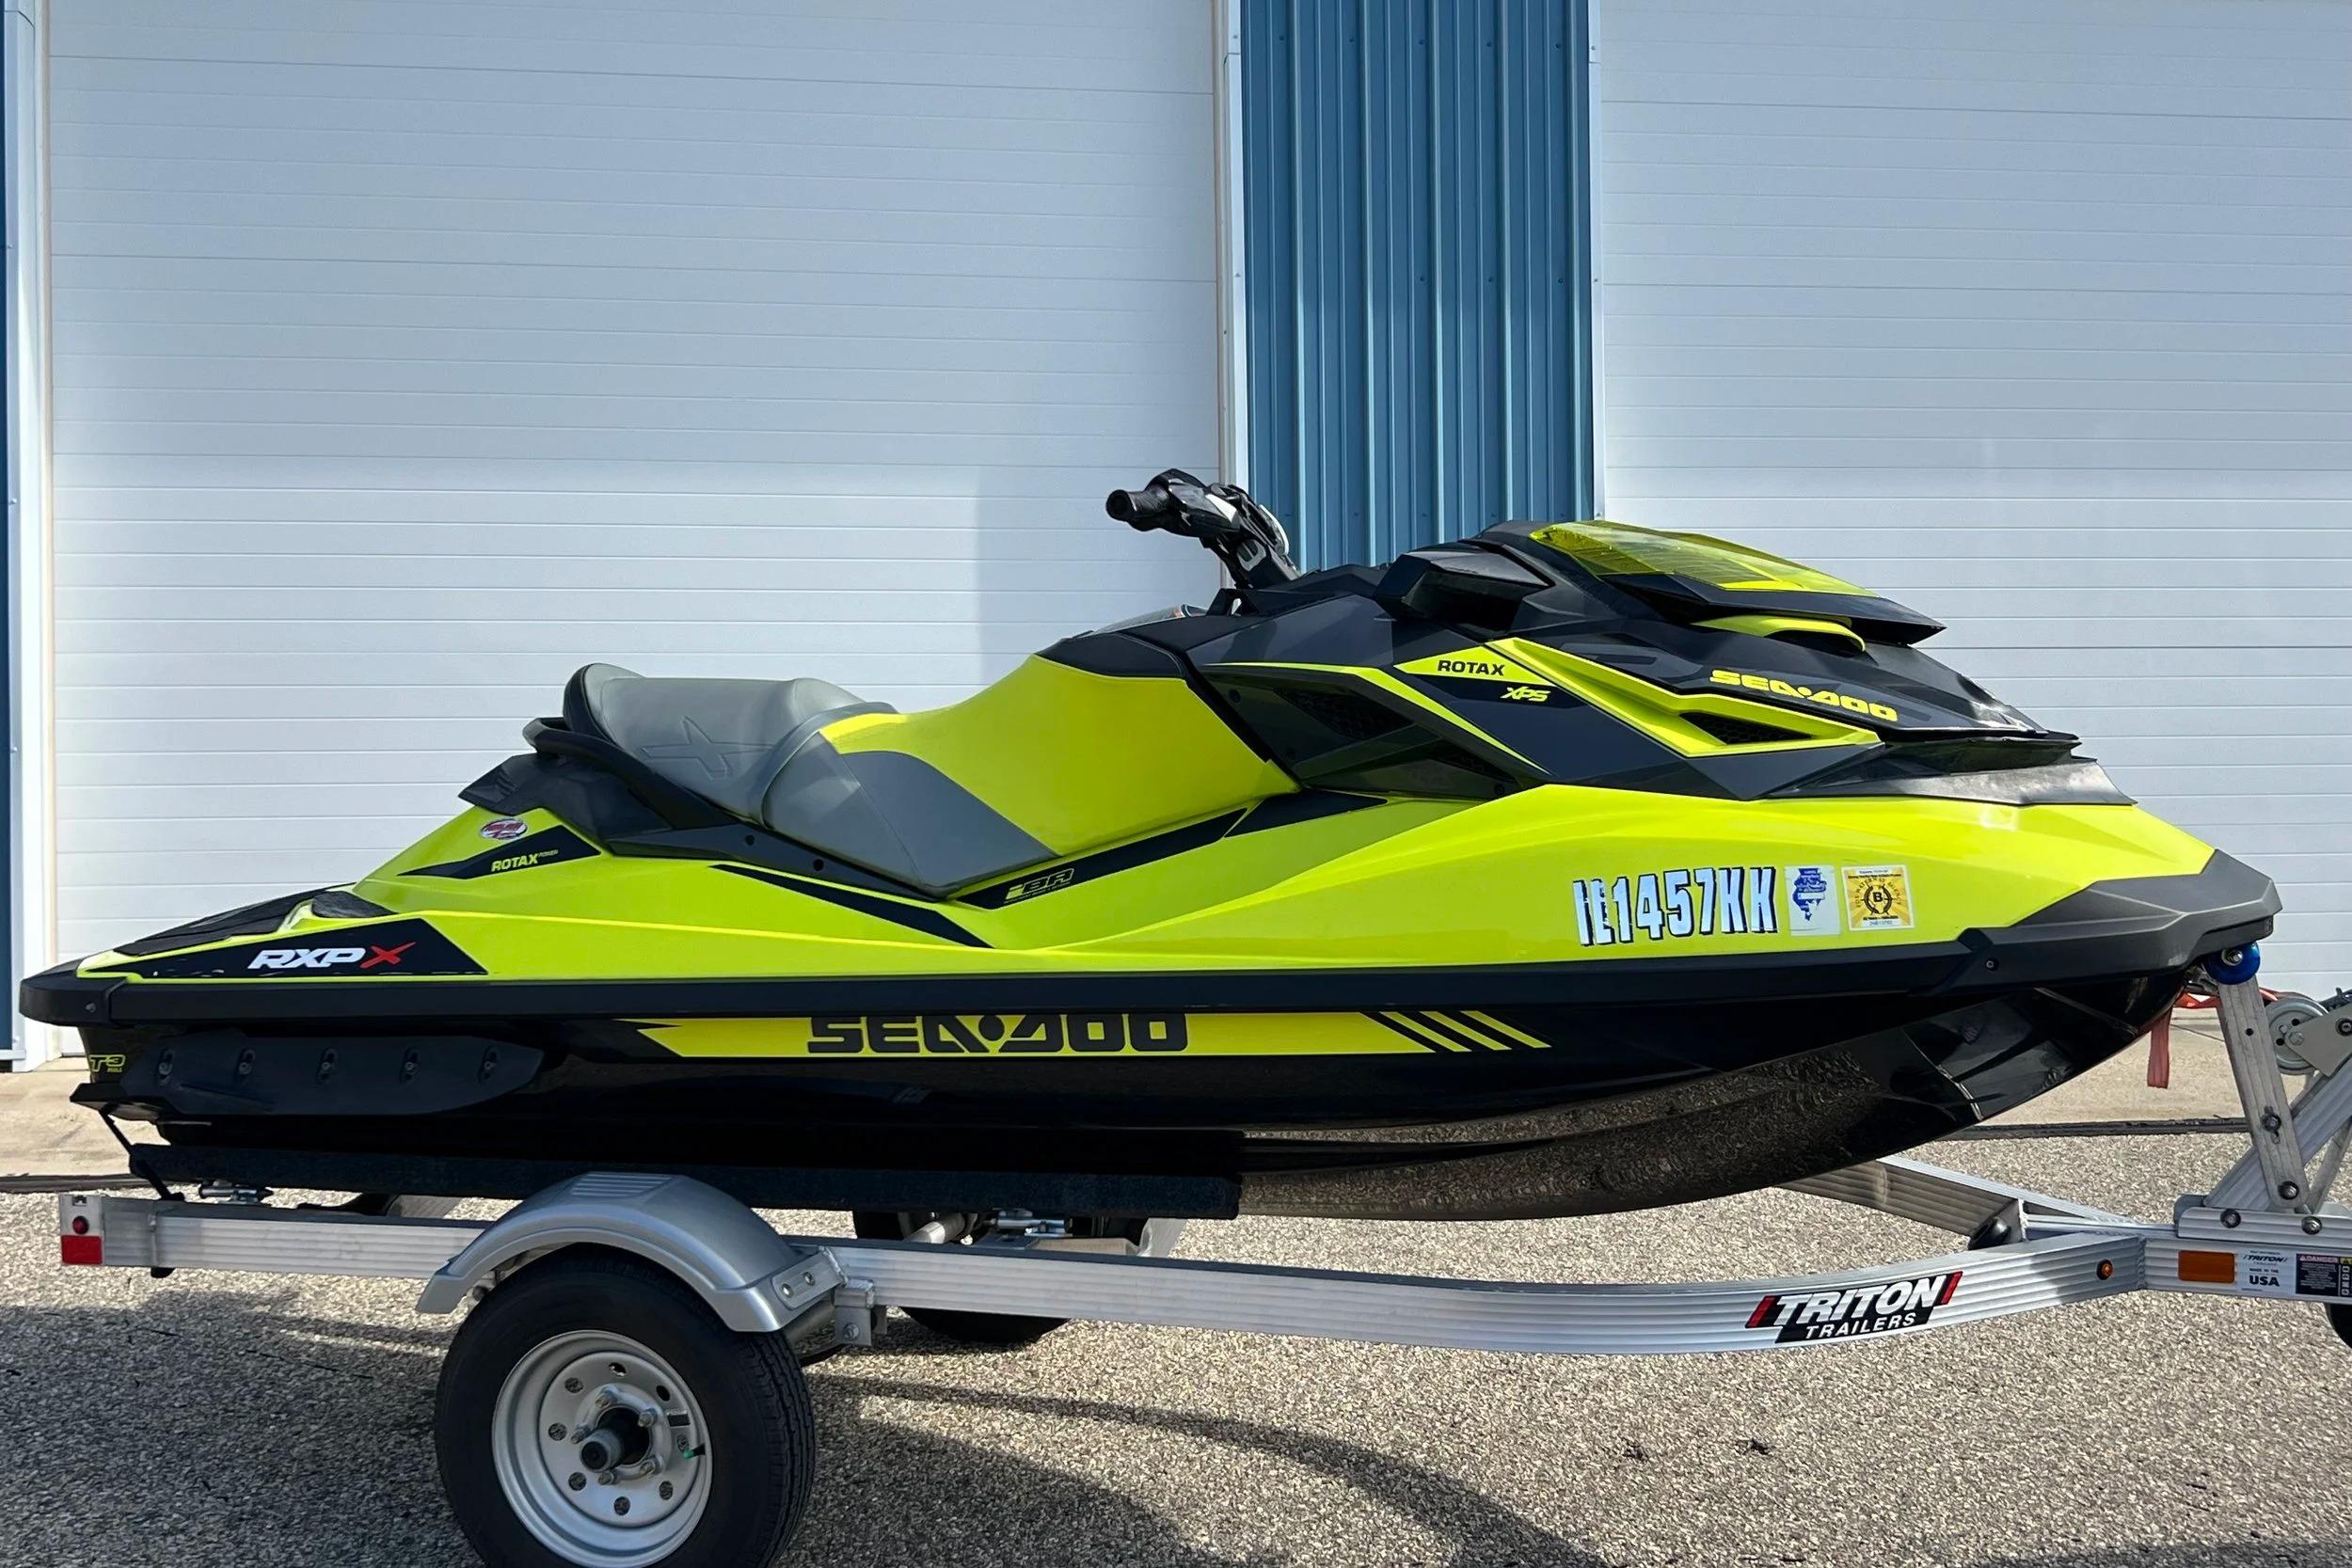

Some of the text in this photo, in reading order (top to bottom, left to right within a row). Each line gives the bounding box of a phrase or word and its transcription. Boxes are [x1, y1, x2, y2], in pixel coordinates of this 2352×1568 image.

[1438, 659, 1505, 676] ROTAX
[1500, 686, 1551, 703] XPS
[491, 854, 538, 872] ROTAX
[2249, 1275, 2280, 1288] USA
[1773, 1275, 1947, 1325] TRITON
[1805, 1312, 1916, 1339] TRAILERS
